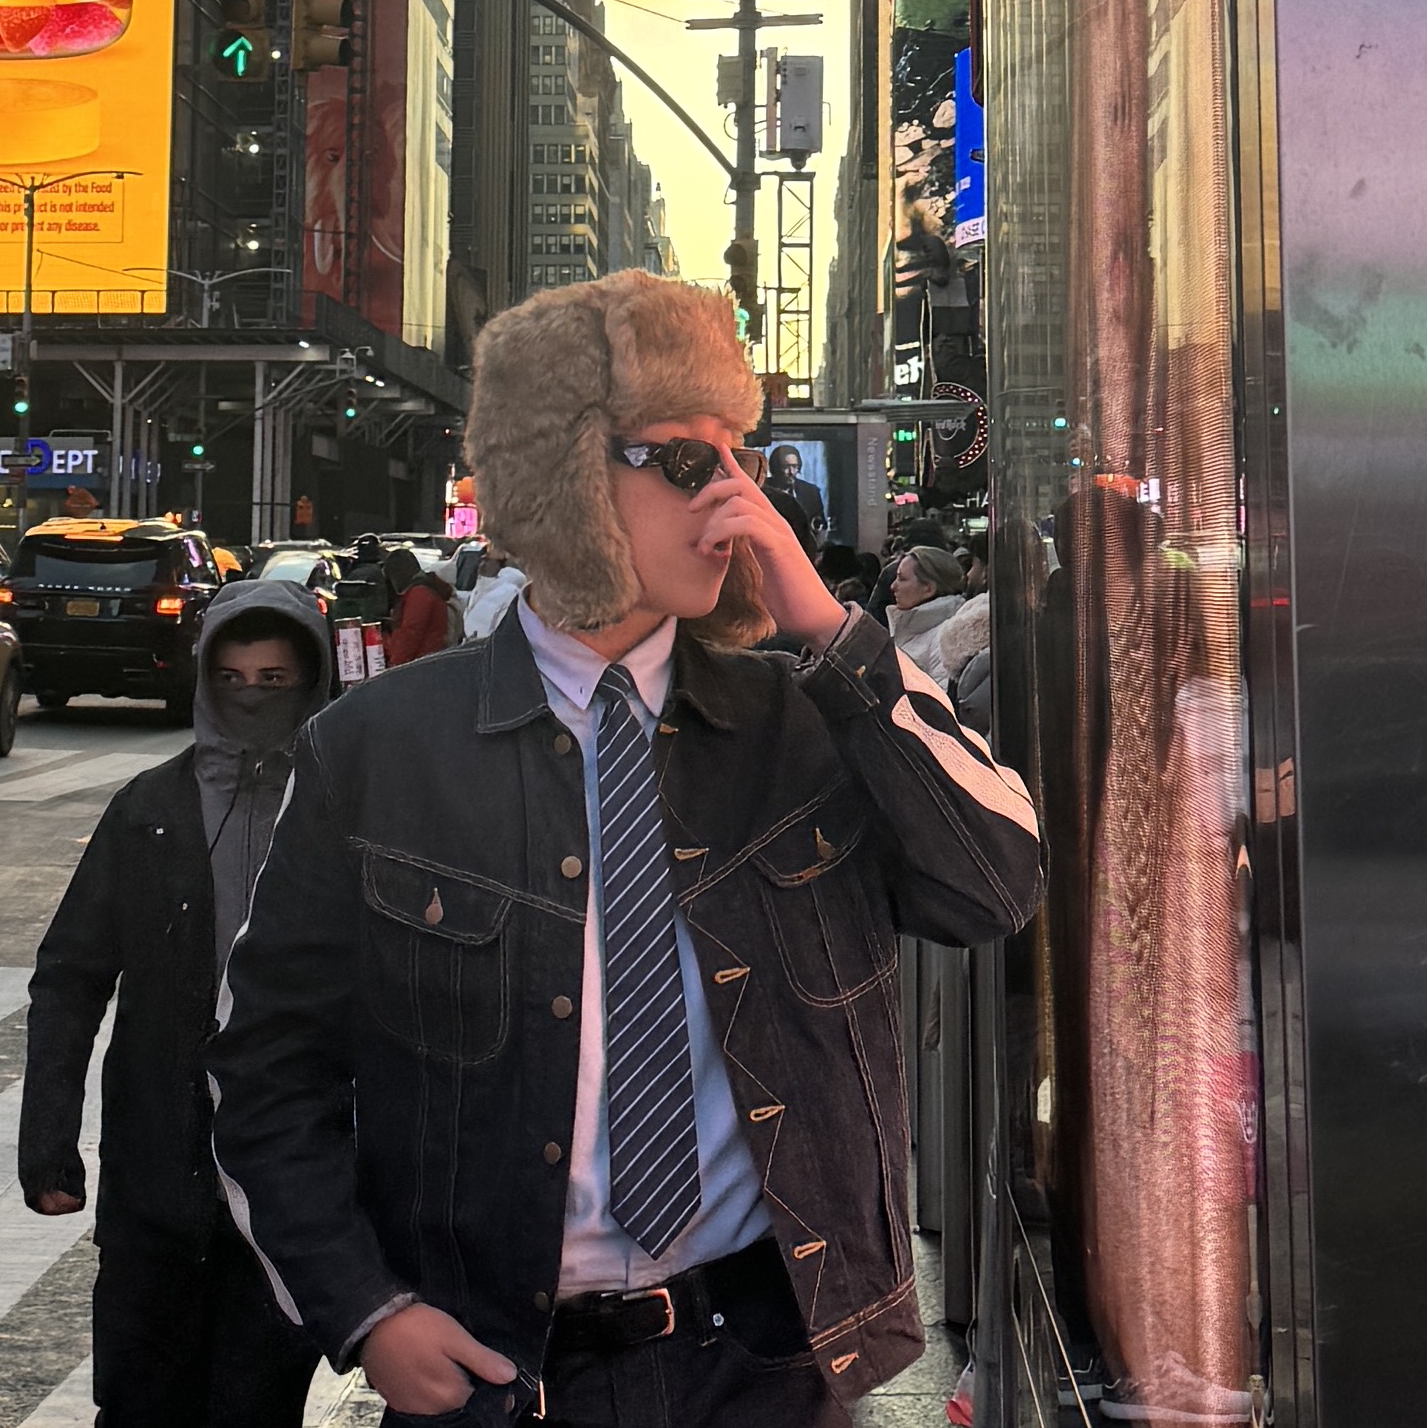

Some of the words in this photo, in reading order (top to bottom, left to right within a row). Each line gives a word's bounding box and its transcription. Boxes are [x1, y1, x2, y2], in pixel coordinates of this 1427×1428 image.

[62, 183, 72, 196] by
[74, 182, 88, 193] the
[91, 182, 112, 193] Food
[50, 201, 57, 212] is
[59, 202, 73, 212] not
[76, 201, 114, 212] intended
[0, 222, 9, 231] or
[47, 222, 62, 233] any
[26, 438, 98, 474] DEPT
